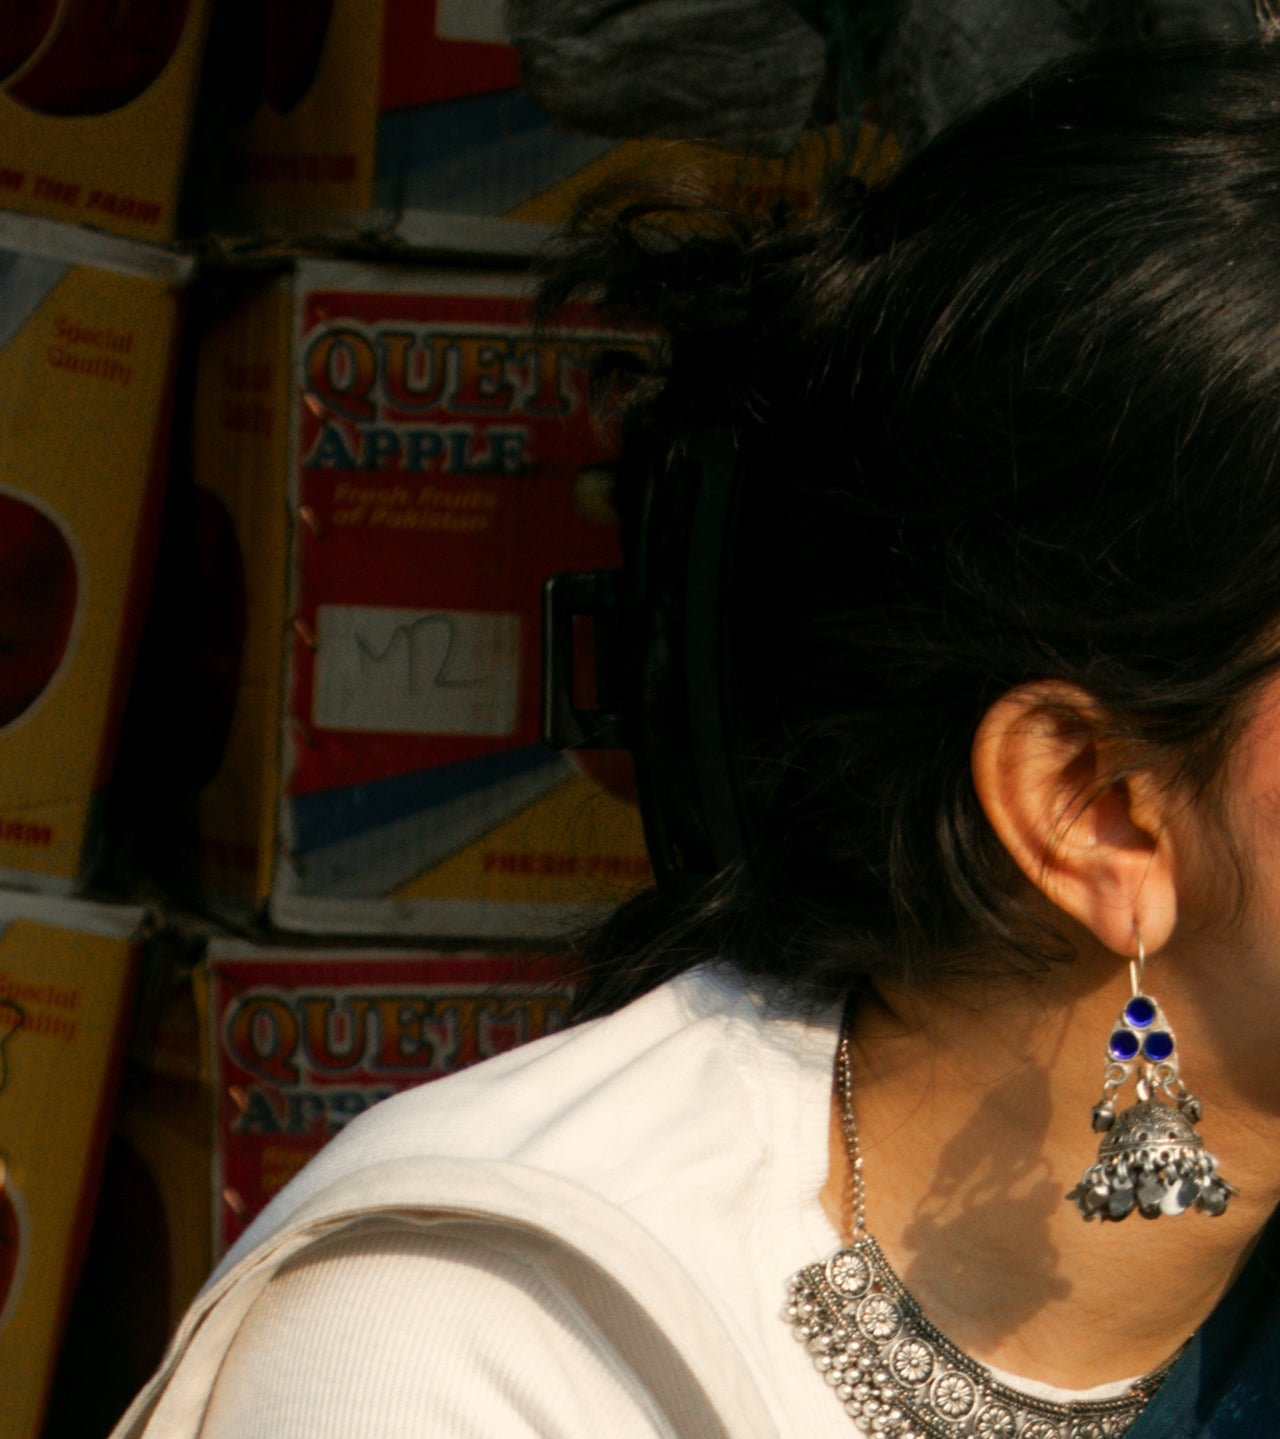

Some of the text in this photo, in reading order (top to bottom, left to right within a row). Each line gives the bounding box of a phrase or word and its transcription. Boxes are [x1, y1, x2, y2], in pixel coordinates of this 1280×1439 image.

[31, 175, 80, 207] THE
[85, 187, 163, 227] FARM
[305, 426, 530, 474] APPLE
